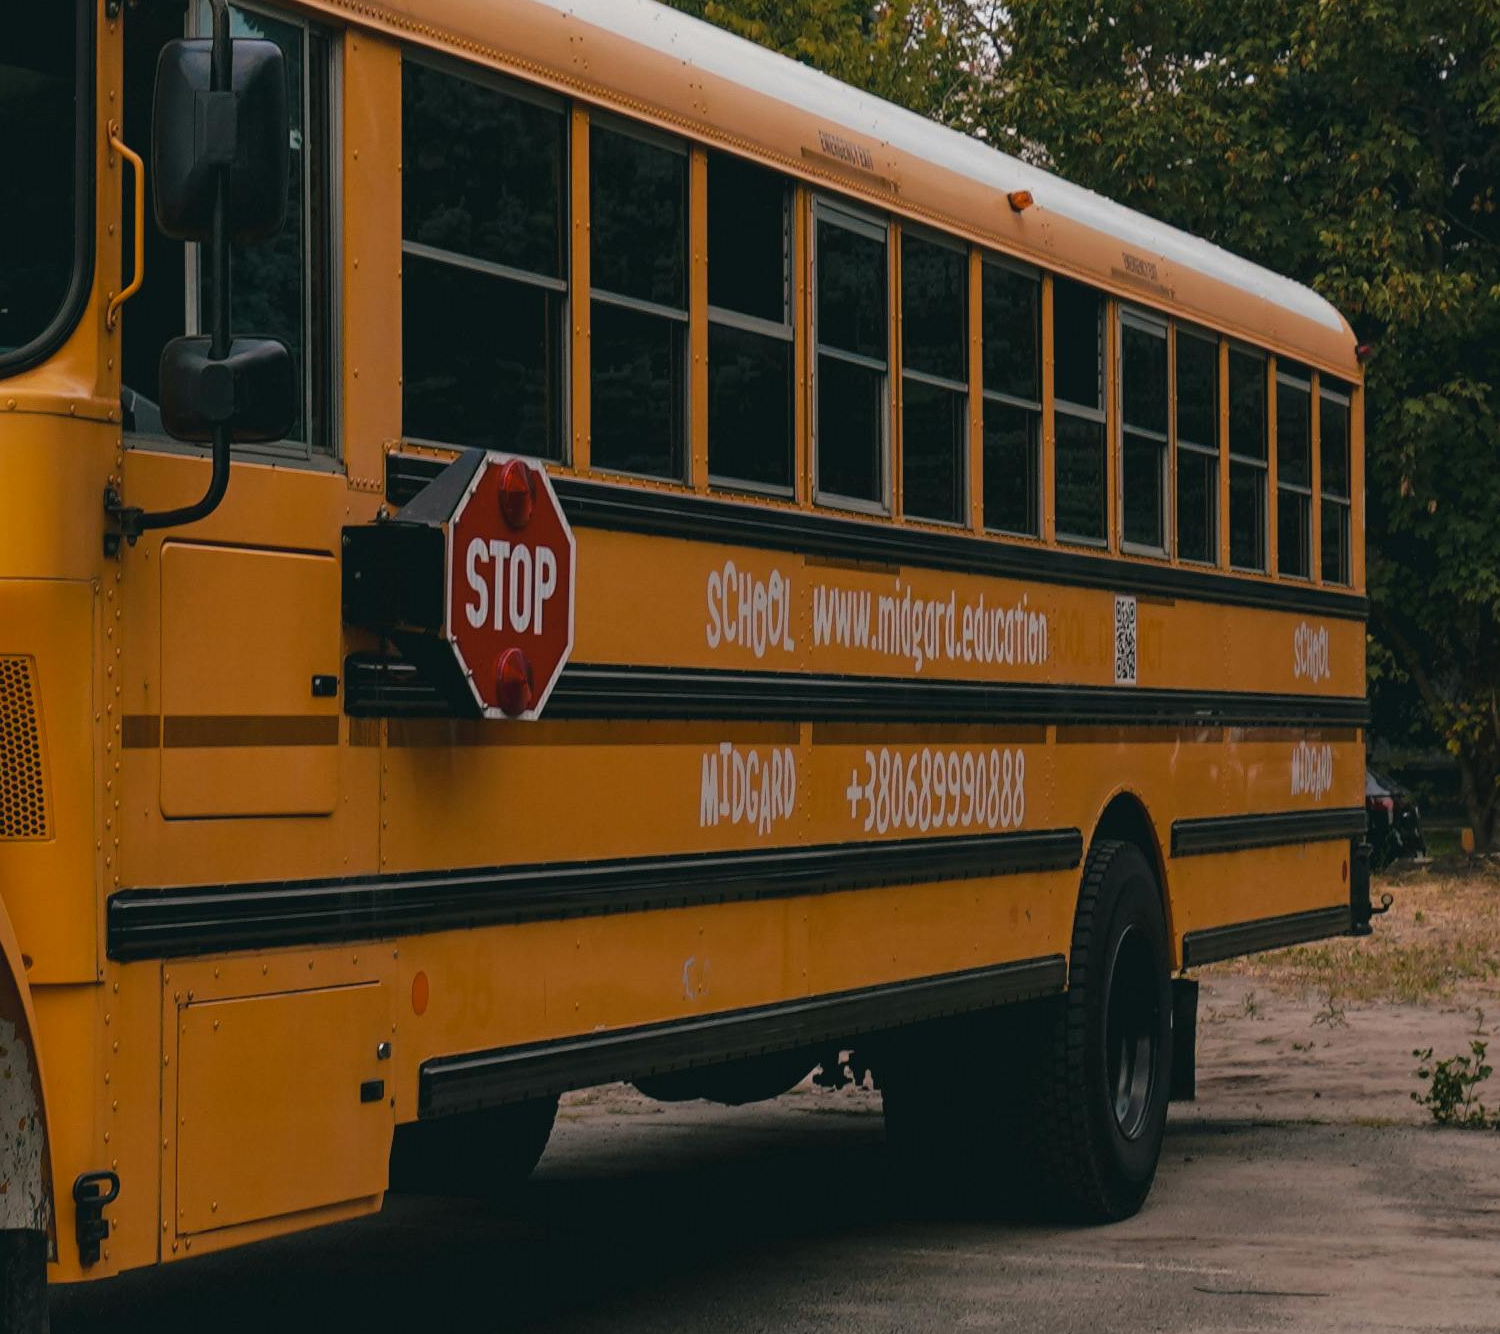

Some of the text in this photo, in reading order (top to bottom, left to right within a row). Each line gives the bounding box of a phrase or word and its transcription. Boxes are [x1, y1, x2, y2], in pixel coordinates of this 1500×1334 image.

[465, 537, 557, 635] STOP
[706, 560, 795, 658] SCHOOL
[813, 578, 1048, 672] www.midgard.education
[1293, 621, 1330, 683] SCHOOL
[700, 742, 796, 836] MIDGARD
[846, 747, 1025, 834] +380689990888
[1291, 740, 1333, 801] MIDGARD
